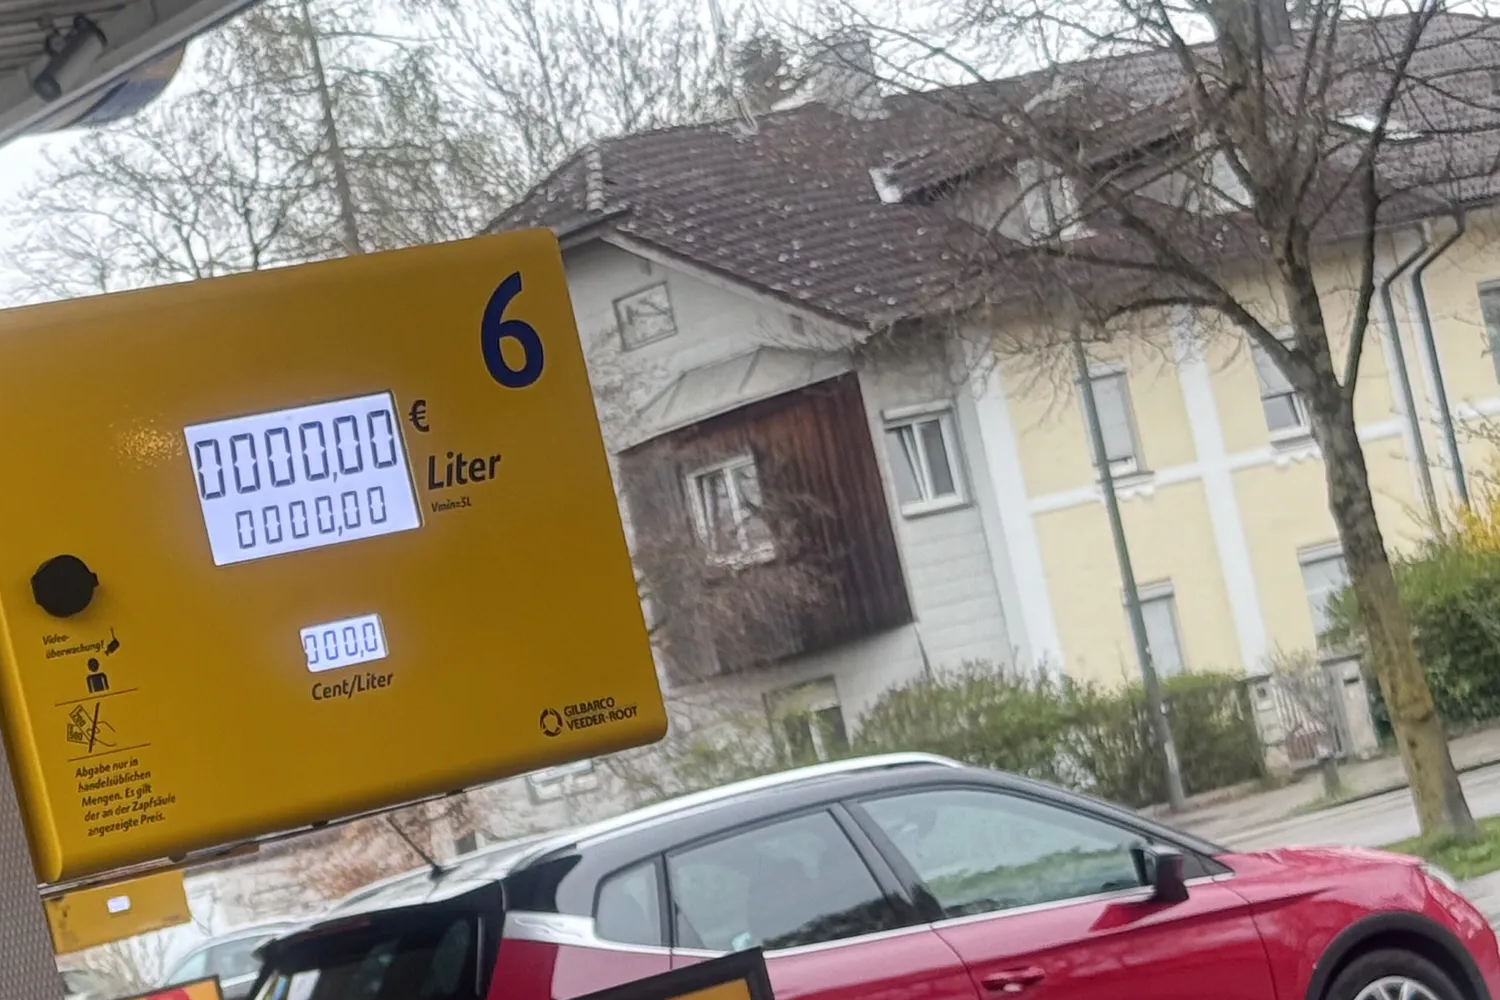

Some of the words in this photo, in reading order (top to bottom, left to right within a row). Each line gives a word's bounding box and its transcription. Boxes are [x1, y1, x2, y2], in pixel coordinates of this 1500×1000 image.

[481, 270, 544, 388] 6
[409, 399, 429, 432] €
[428, 451, 502, 490] Liter
[42, 633, 69, 645] Video-
[46, 640, 105, 659] überwachung!
[311, 672, 394, 701] Cent/Liter
[564, 696, 615, 717] GILBARCO
[75, 763, 111, 779] Abgabe
[112, 760, 129, 771] nur
[130, 756, 139, 767] in
[78, 770, 151, 793] handelsüblichen
[81, 792, 123, 807] Mengen.
[125, 787, 135, 798] Es
[136, 783, 152, 799] gilt
[84, 810, 100, 822] der
[102, 808, 113, 818] an
[115, 805, 130, 816] der
[131, 793, 176, 812] Zapfsäule
[88, 818, 139, 837] angezeigte
[140, 811, 165, 825] Preis.
